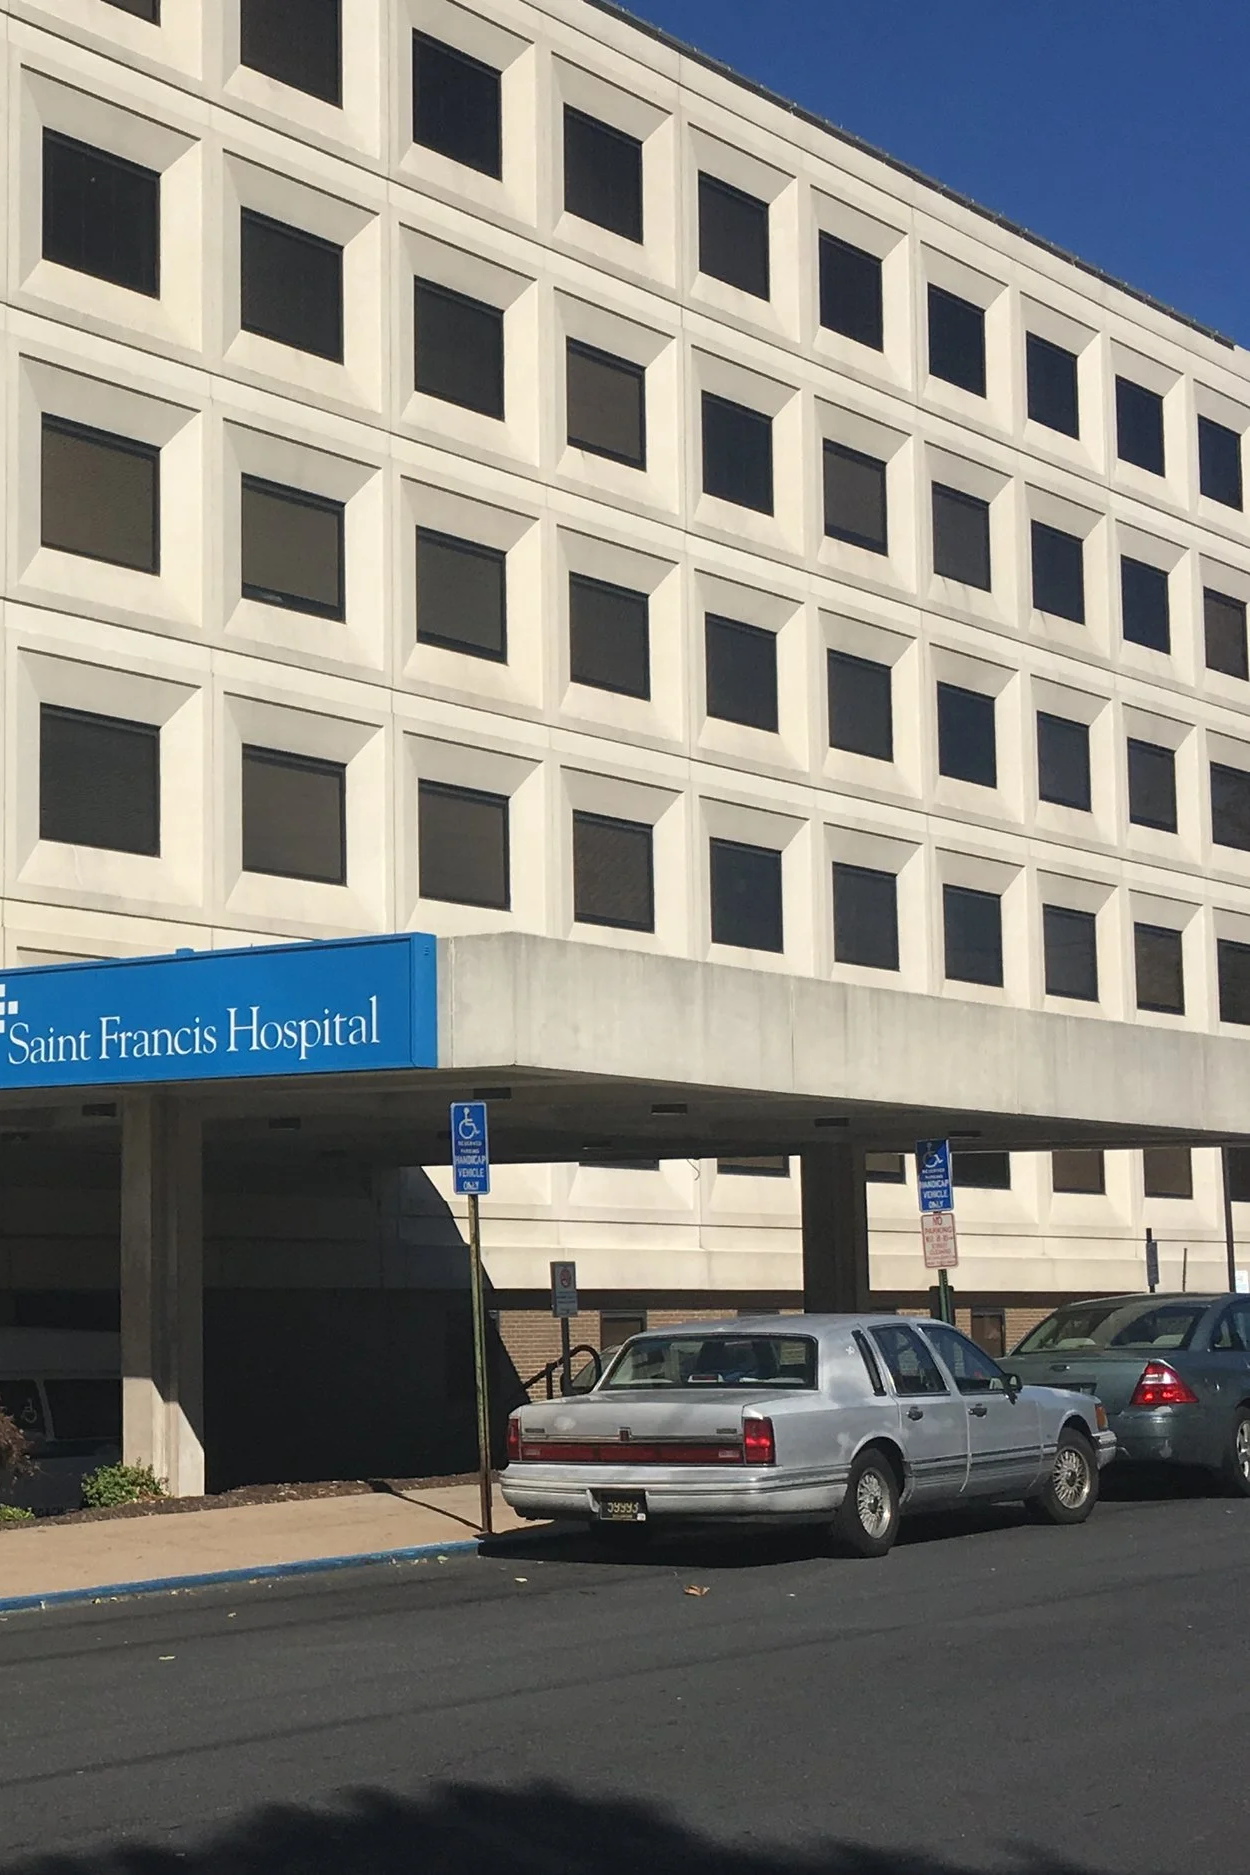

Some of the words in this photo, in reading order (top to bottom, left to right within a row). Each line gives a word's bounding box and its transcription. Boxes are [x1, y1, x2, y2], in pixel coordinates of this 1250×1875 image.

[8, 1022, 91, 1065] Saint
[99, 1015, 217, 1060] Francis
[226, 995, 380, 1060] Hospital
[455, 1155, 486, 1164] HANDICAP
[458, 1168, 485, 1177] VEHICLE
[463, 1181, 479, 1190] ONLY
[923, 1190, 948, 1198] VEHICLE
[928, 1200, 944, 1208] ONLY
[933, 1216, 942, 1225] NO
